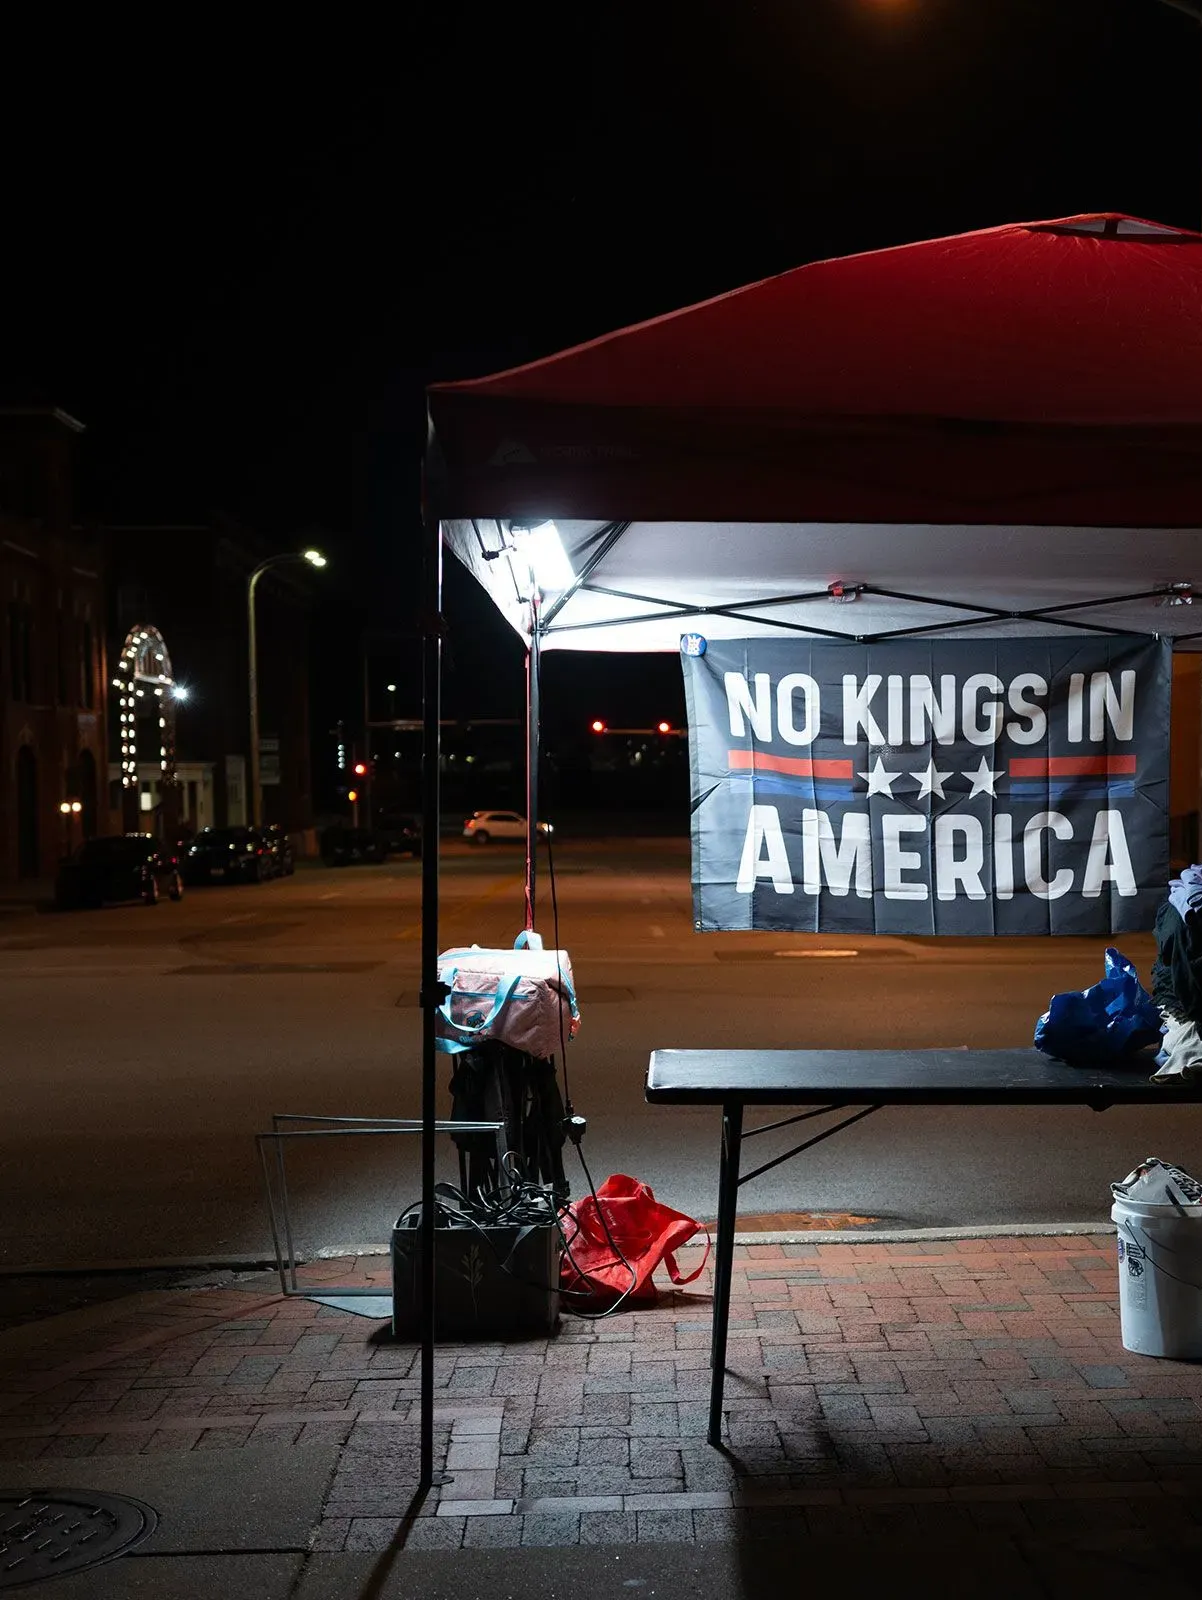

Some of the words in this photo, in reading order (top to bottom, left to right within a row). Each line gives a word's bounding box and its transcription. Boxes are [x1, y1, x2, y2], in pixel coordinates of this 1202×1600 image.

[724, 671, 821, 746] NO
[842, 672, 1049, 746] KINGS
[1067, 669, 1137, 743] IN
[735, 804, 1138, 901] AMERICA
